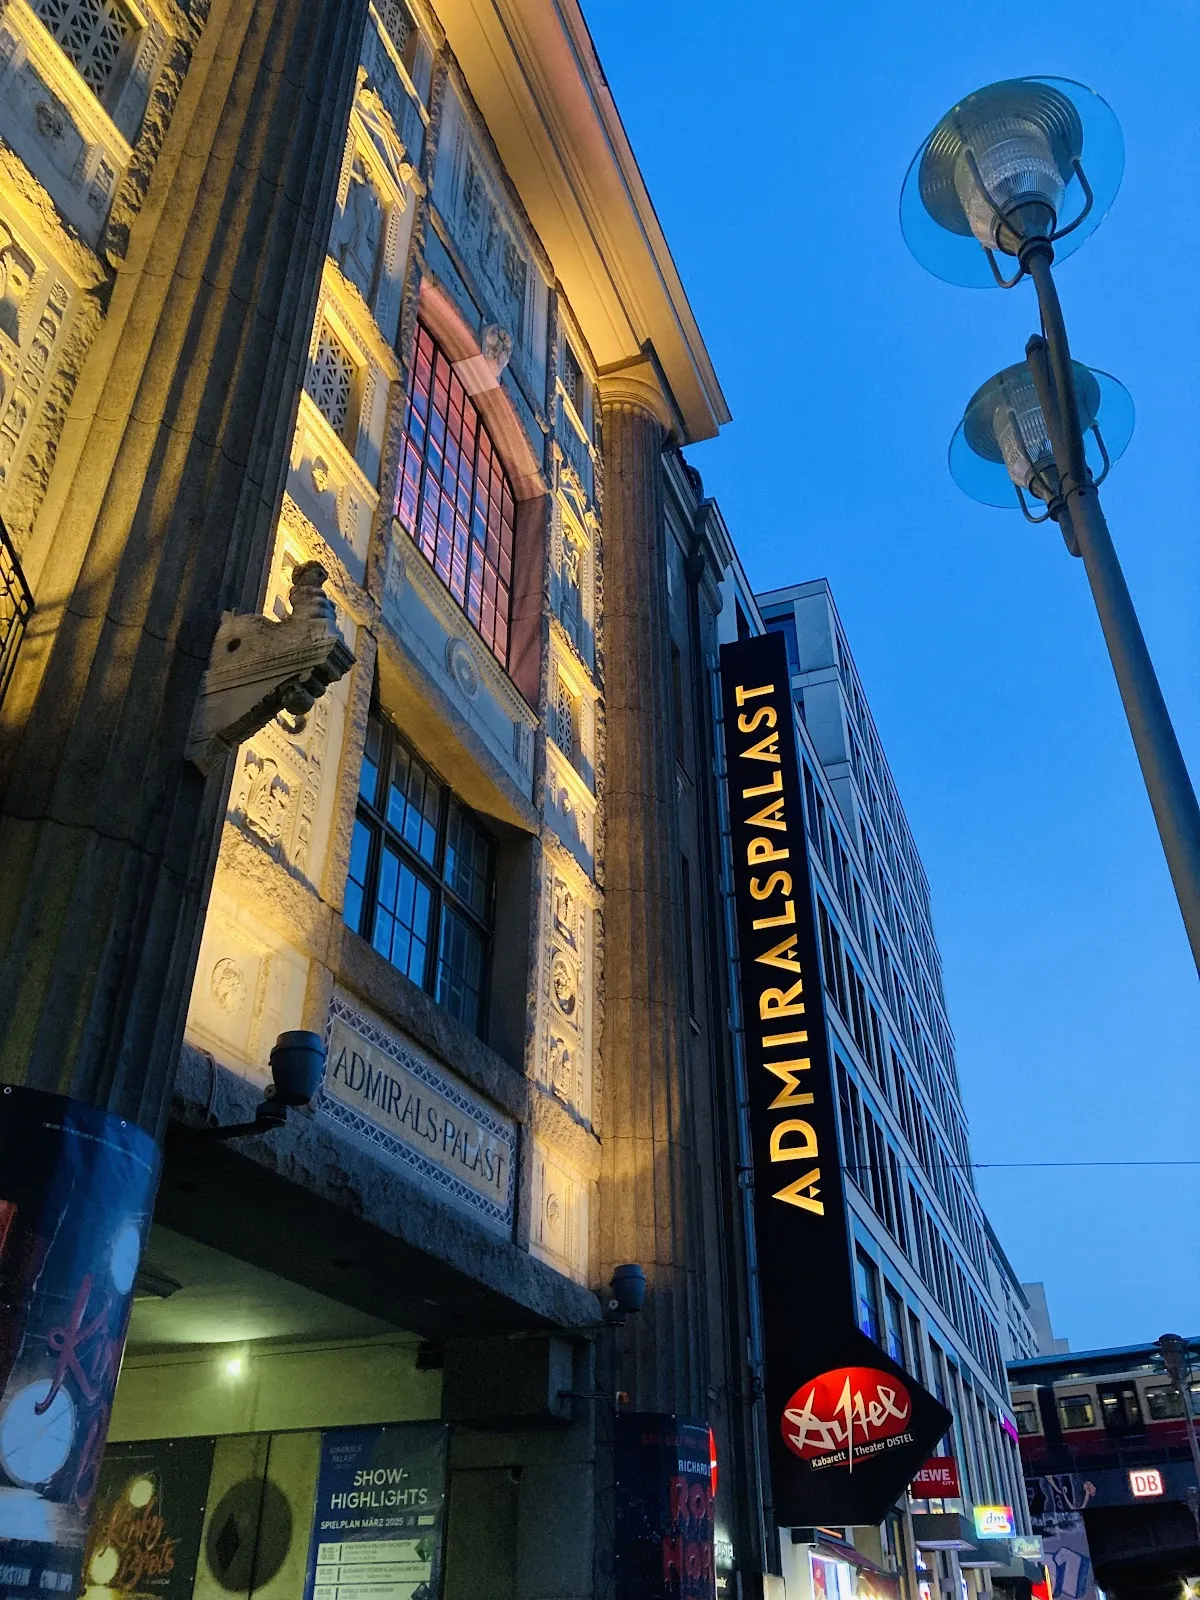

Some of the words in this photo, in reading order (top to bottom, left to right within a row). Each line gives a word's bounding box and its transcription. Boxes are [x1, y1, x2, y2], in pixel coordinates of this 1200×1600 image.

[735, 683, 825, 1217] ADMIRALSPALAST
[811, 1451, 847, 1468] Kabarett
[854, 1440, 886, 1457] Theater
[887, 1433, 915, 1449] DISTEL
[678, 1459, 708, 1476] RICHARD
[354, 1468, 409, 1486] SHOW-
[1135, 1475, 1159, 1492] DB
[331, 1488, 428, 1509] HIGHLIGHTS
[320, 1518, 361, 1530] SPIELPLAN
[361, 1517, 384, 1527] MÄRZ
[385, 1516, 404, 1527] 2025
[986, 1512, 1007, 1525] dm
